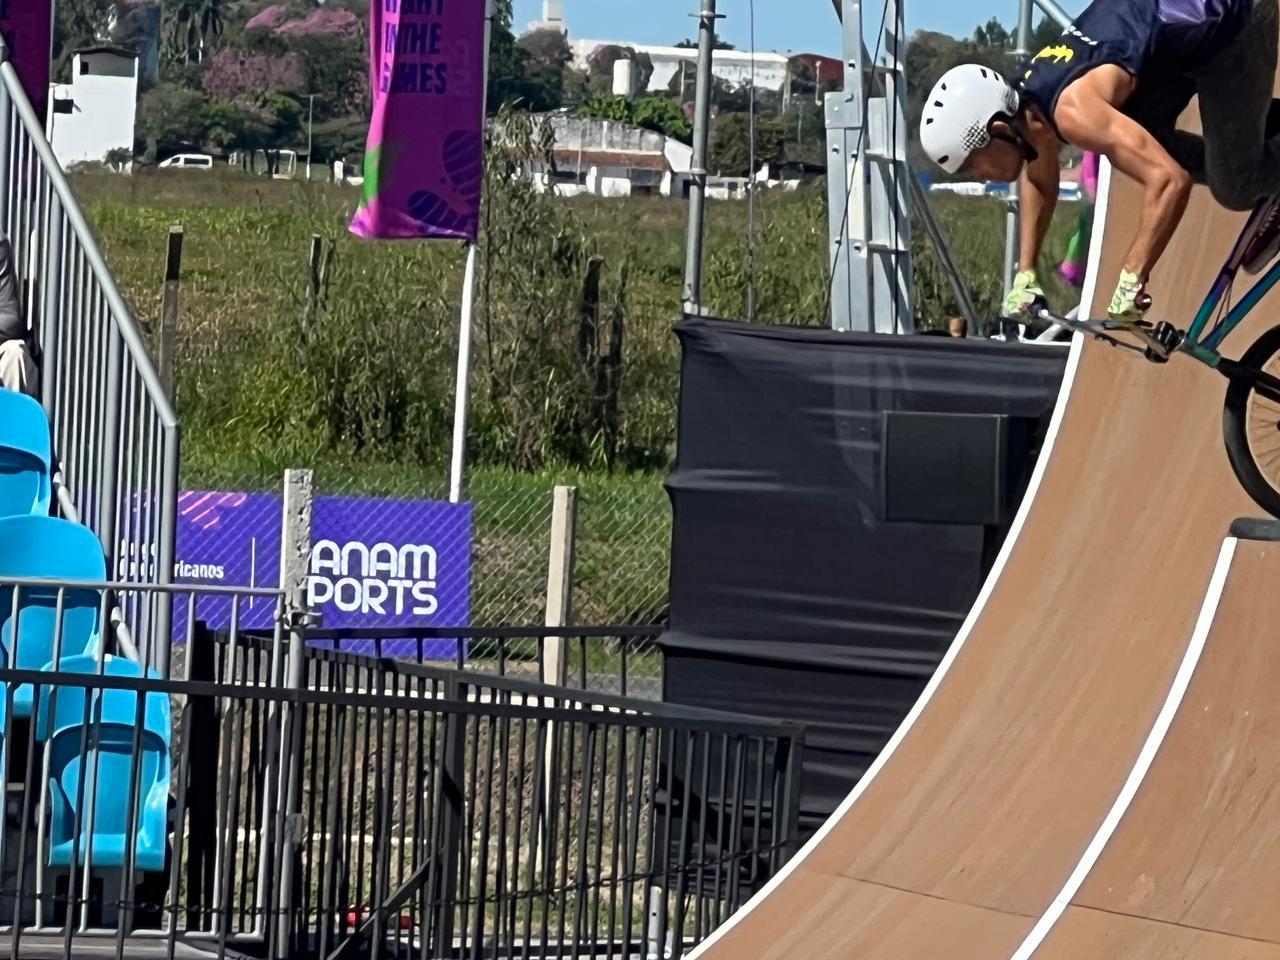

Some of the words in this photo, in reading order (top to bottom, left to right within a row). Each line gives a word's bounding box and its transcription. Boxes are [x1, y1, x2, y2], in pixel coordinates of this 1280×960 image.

[381, 62, 447, 94] MES
[174, 560, 225, 579] ricanos
[311, 539, 437, 579] ANAM
[306, 575, 438, 615] PORTS
